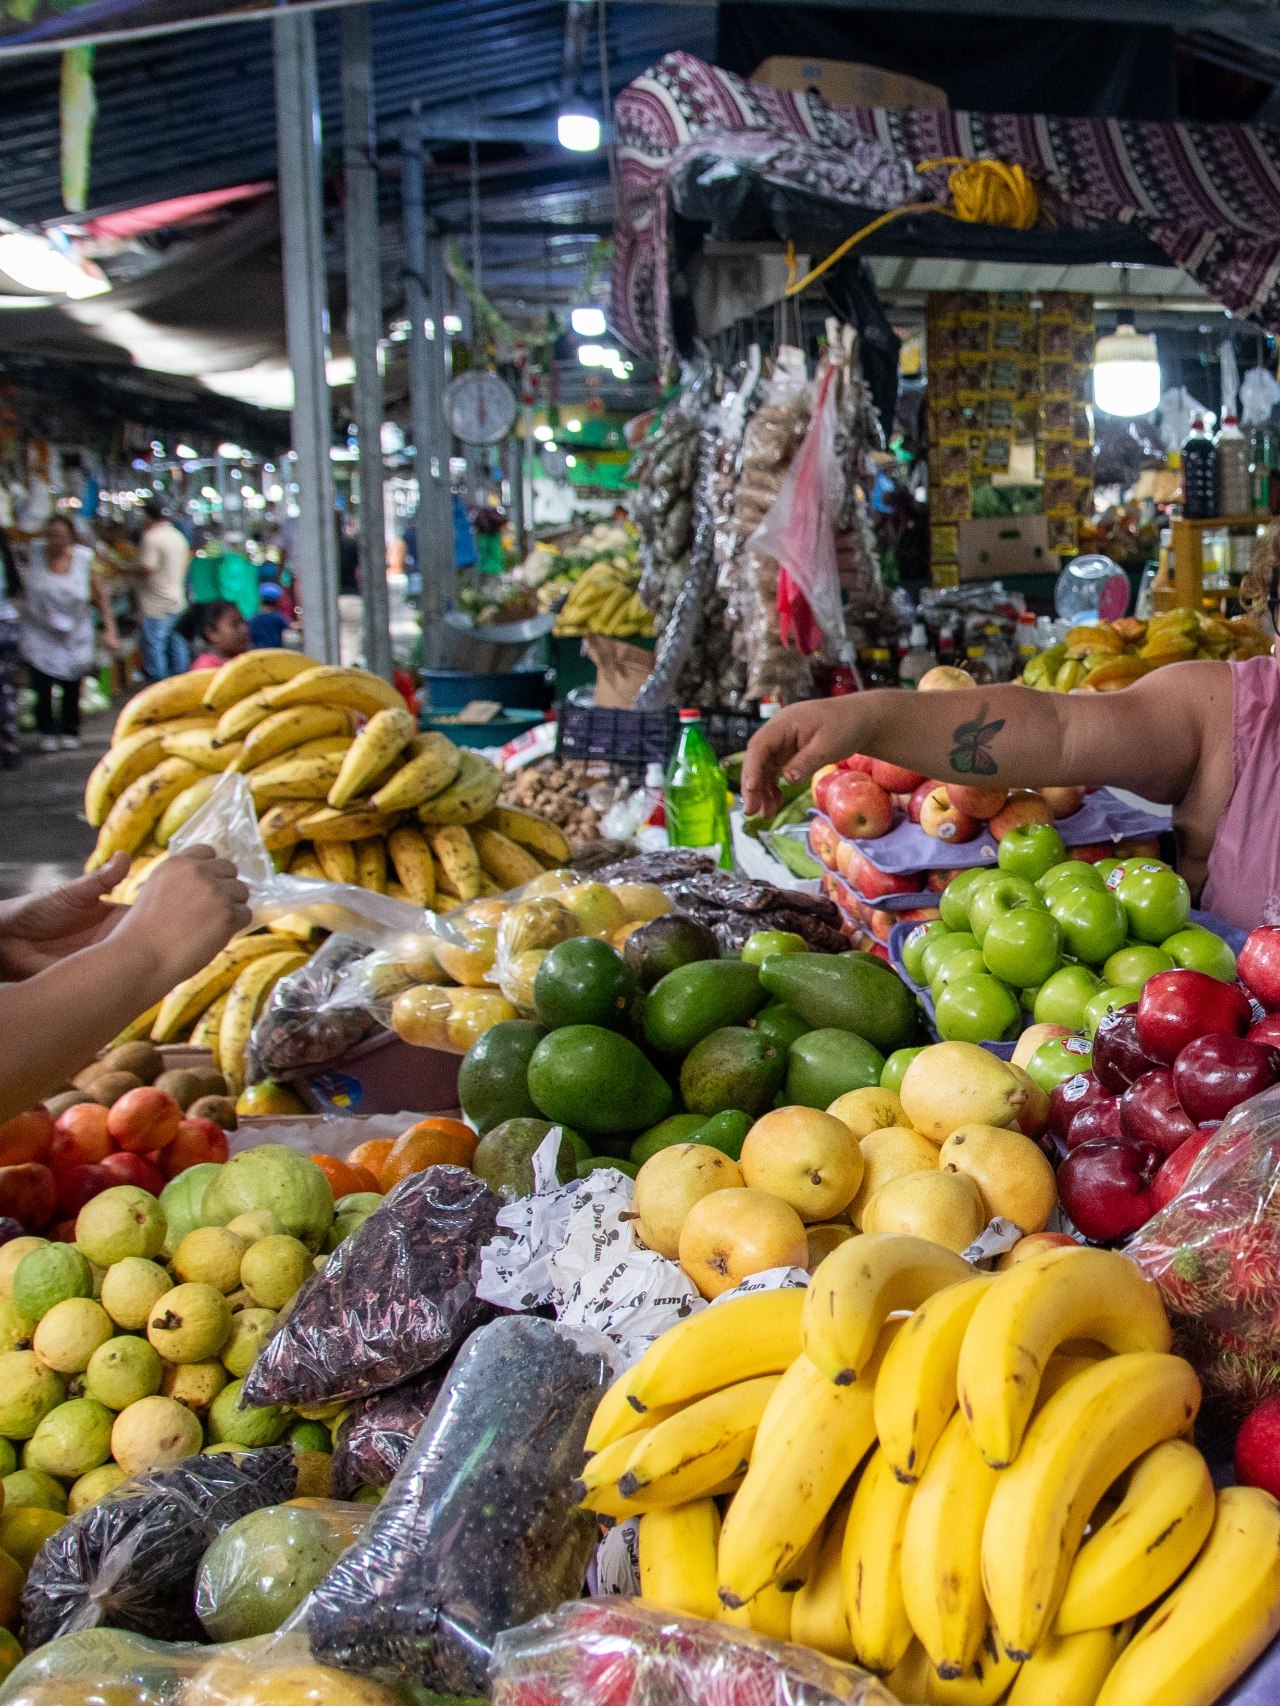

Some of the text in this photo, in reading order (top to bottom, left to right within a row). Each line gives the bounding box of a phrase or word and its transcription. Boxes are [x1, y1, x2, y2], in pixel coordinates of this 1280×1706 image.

[592, 1203, 605, 1230] Don
[592, 1233, 606, 1262] Juan
[600, 1263, 628, 1295] Don
[653, 1293, 692, 1306] Juan
